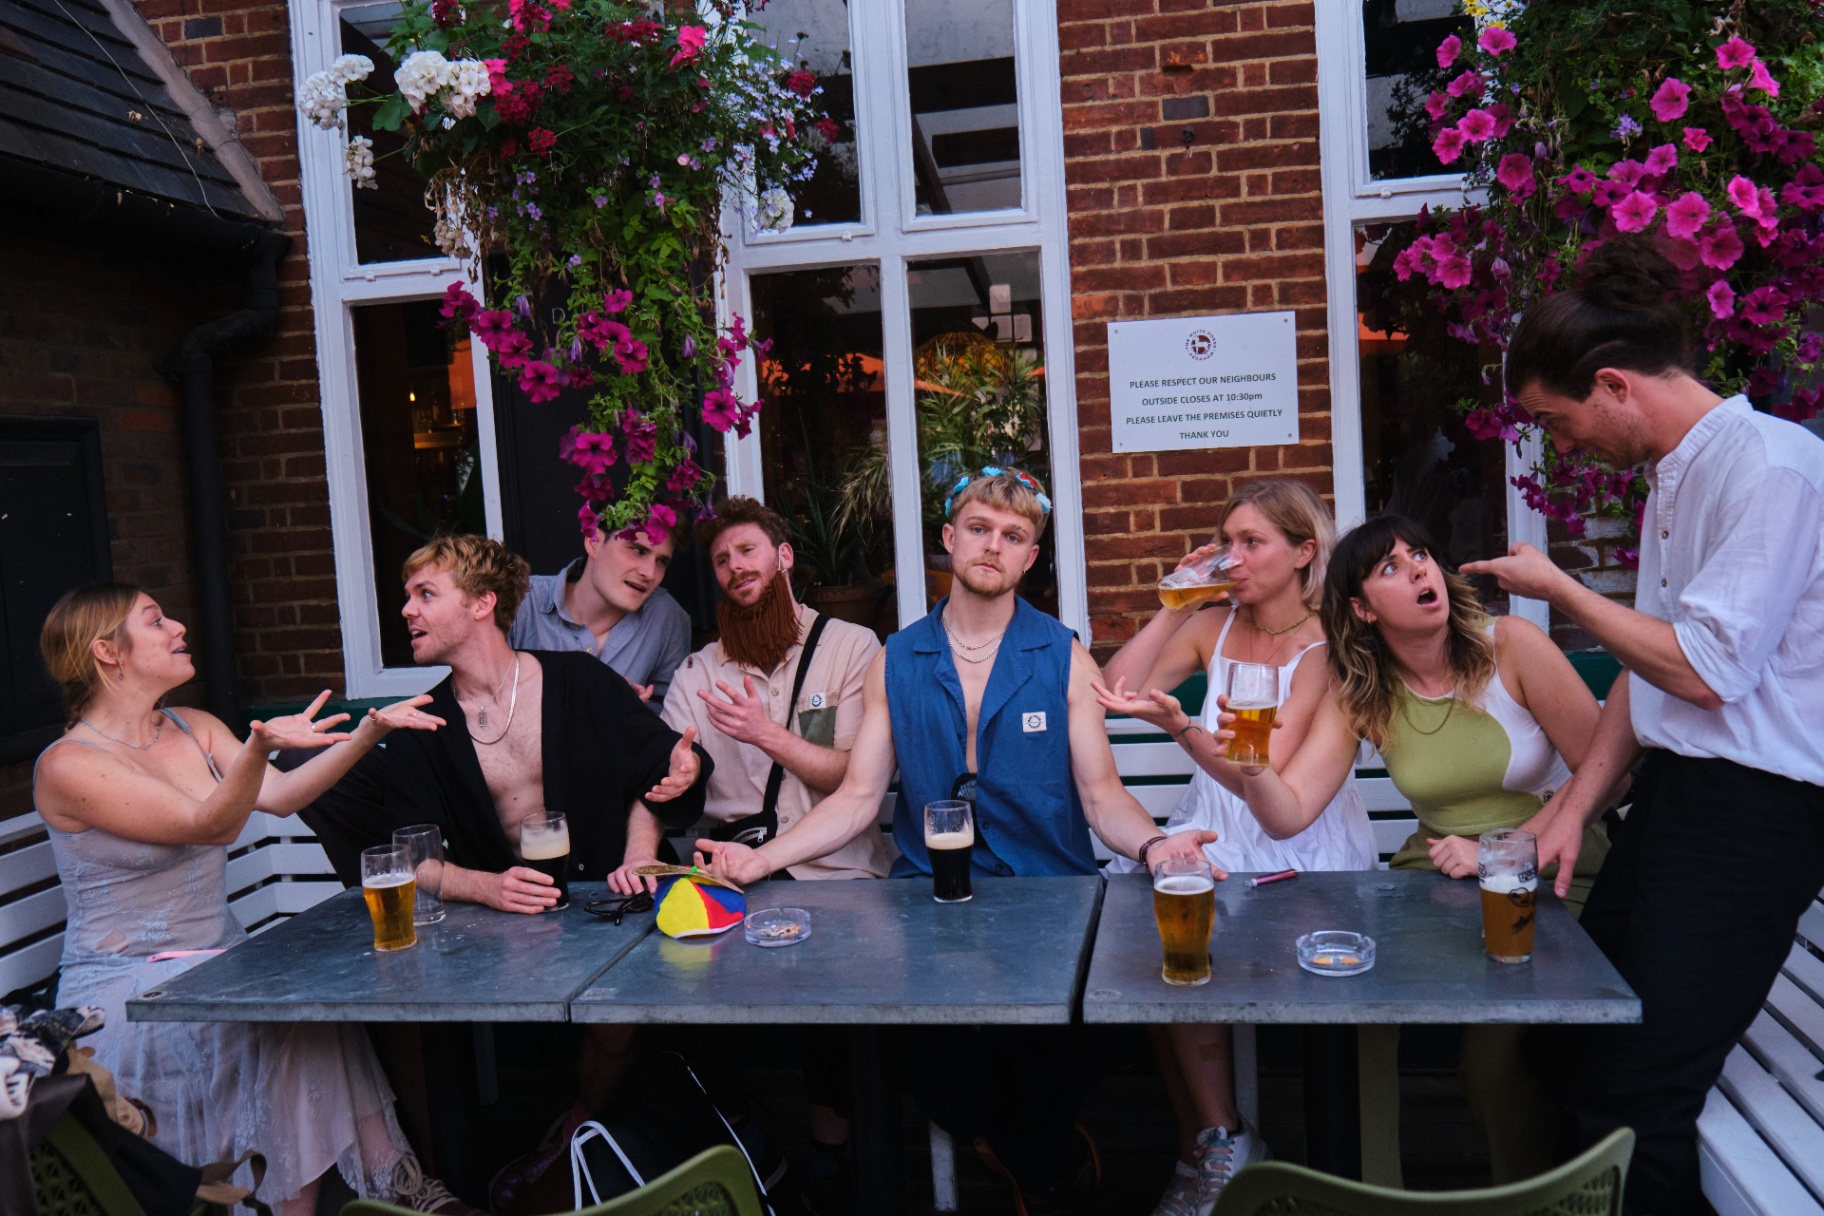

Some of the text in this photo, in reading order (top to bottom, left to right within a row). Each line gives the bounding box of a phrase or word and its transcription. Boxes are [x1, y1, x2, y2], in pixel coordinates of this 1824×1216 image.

[1189, 329, 1206, 338] WHITE
[1207, 331, 1217, 349] HORSE
[1188, 351, 1214, 361] PECKHAM
[1129, 373, 1277, 389] PLEASE RESPECT OUR NEIGHBOURS
[1141, 392, 1263, 406] OUTSIDE CLOSES AT 10:30pm
[1126, 409, 1283, 425] PLEASE LEAVE THE PREMISES QUIETLY
[1179, 430, 1230, 440] THANK YOU
